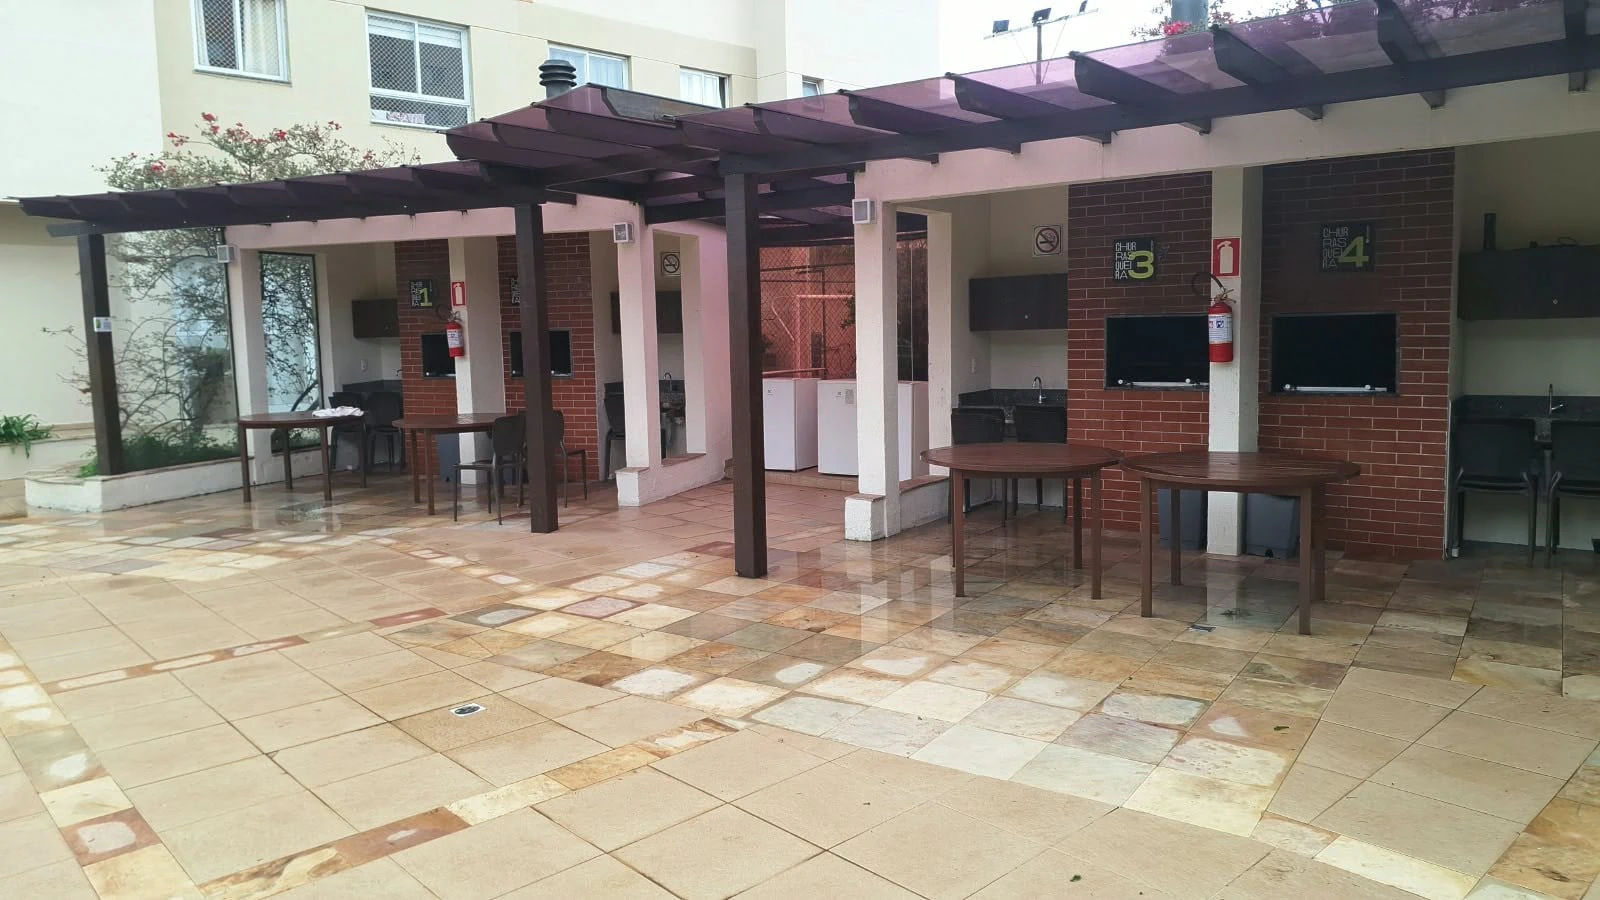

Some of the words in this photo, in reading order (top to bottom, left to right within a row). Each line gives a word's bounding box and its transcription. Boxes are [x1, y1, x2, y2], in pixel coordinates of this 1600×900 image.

[1115, 241, 1137, 252] CHUR
[1339, 236, 1369, 267] 4
[1127, 250, 1154, 279] 3
[1115, 270, 1128, 280] RA
[420, 287, 433, 307] 1
